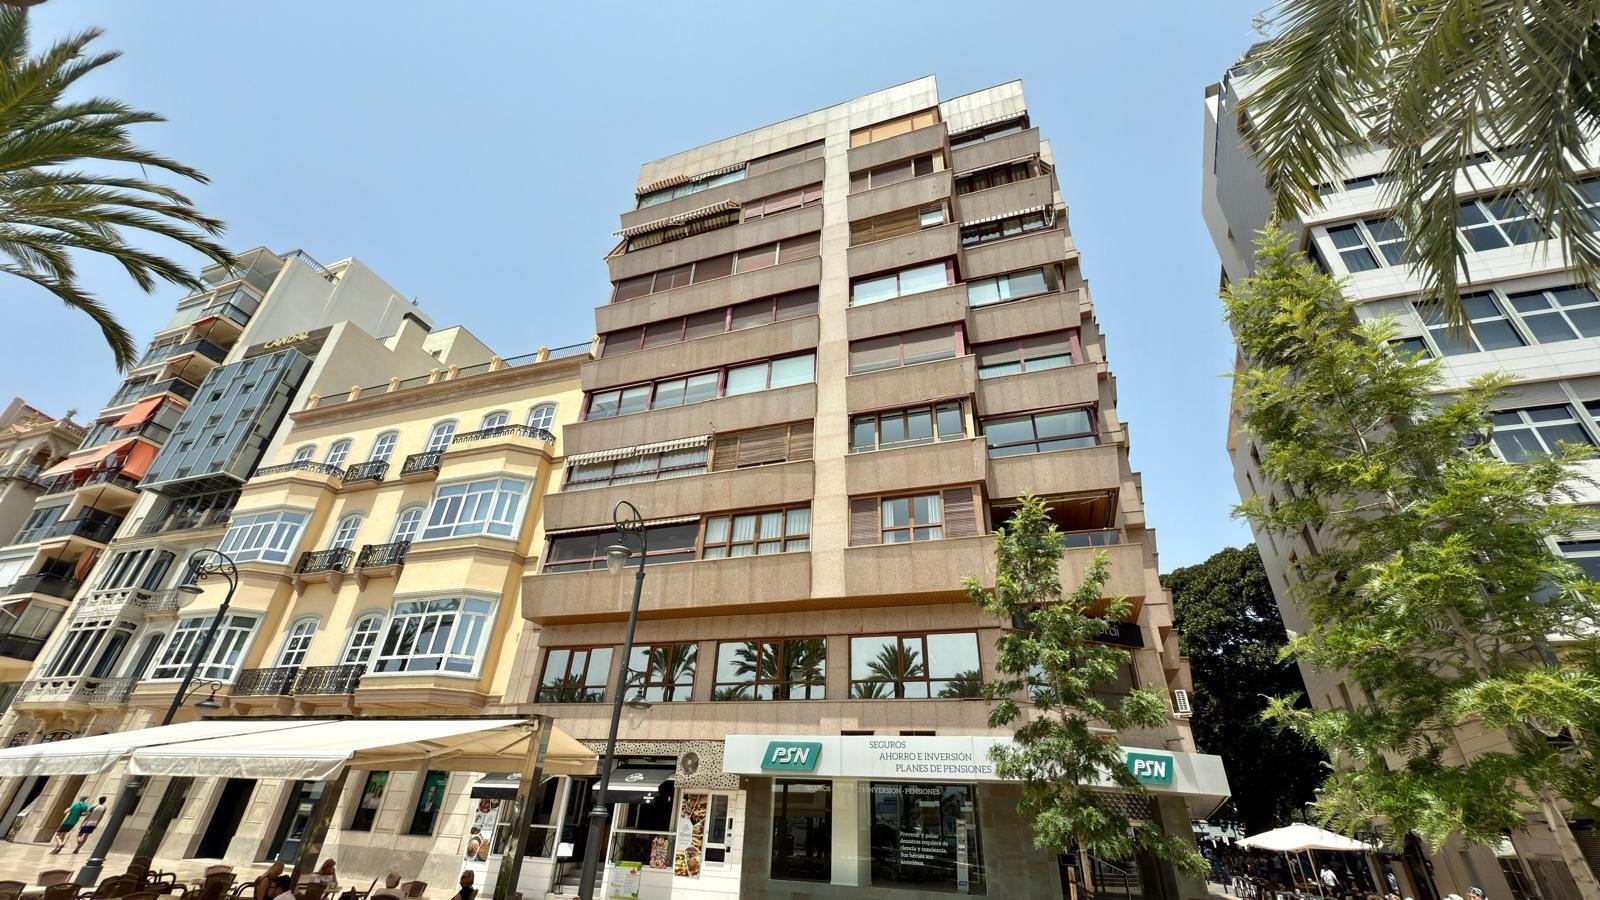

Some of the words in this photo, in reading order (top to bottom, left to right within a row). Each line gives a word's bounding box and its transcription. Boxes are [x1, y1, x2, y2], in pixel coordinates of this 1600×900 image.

[869, 741, 906, 749] SEGUROS
[772, 747, 810, 764] PSN
[880, 752, 916, 761] AHORRO
[917, 752, 923, 761] E
[924, 752, 972, 761] INVERSIÓN
[896, 763, 929, 773] PLANES
[930, 764, 942, 773] DE
[943, 764, 992, 774] PENSIONES
[1134, 759, 1166, 778] PSN
[905, 787, 940, 796] PENSIONES
